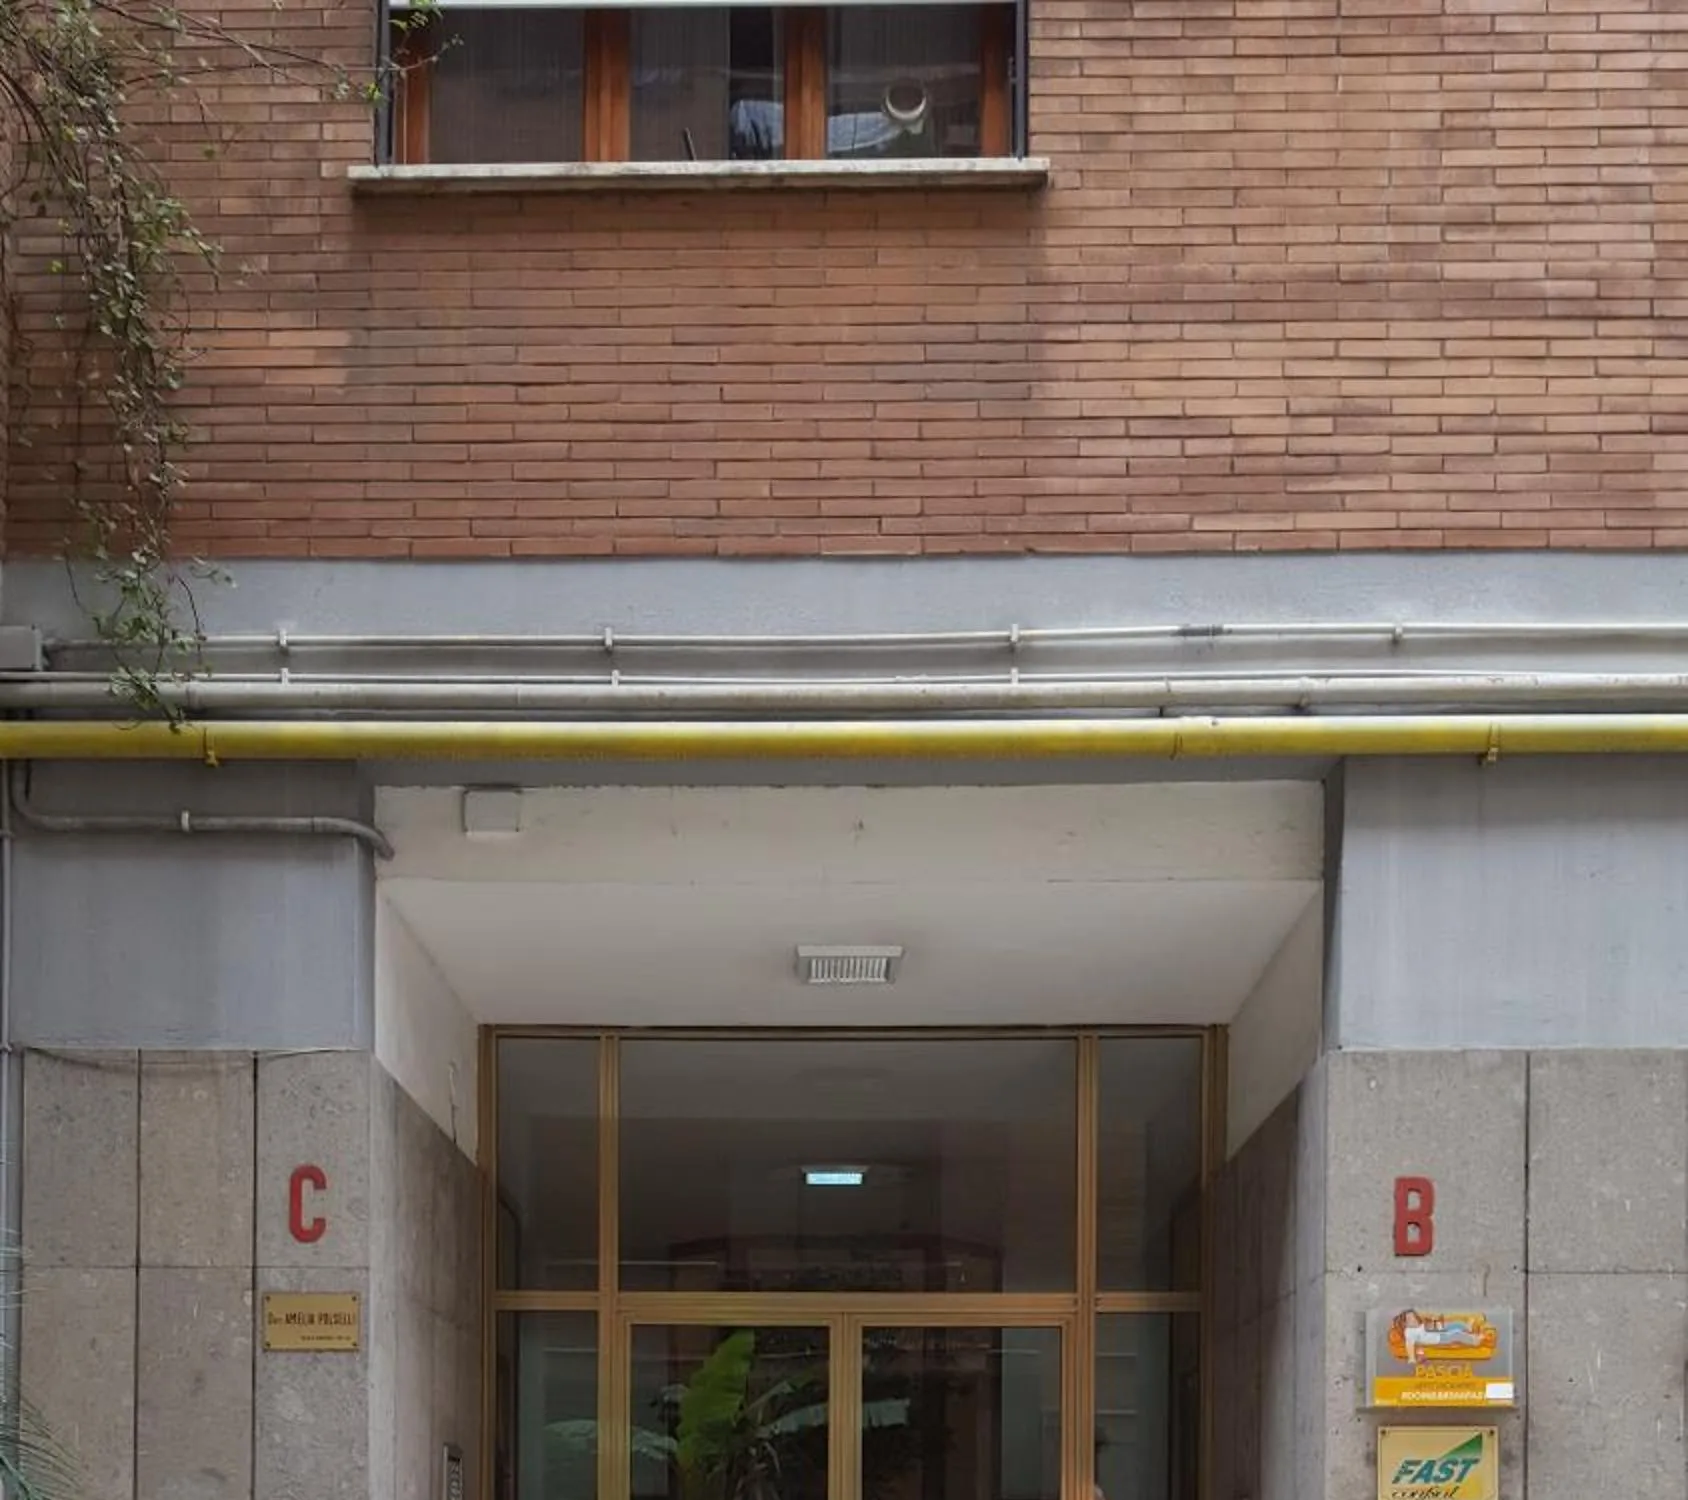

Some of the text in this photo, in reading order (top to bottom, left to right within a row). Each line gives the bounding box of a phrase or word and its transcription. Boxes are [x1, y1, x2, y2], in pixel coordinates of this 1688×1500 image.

[289, 1164, 327, 1243] C
[1393, 1176, 1435, 1257] B
[1391, 1459, 1480, 1484] FAST
